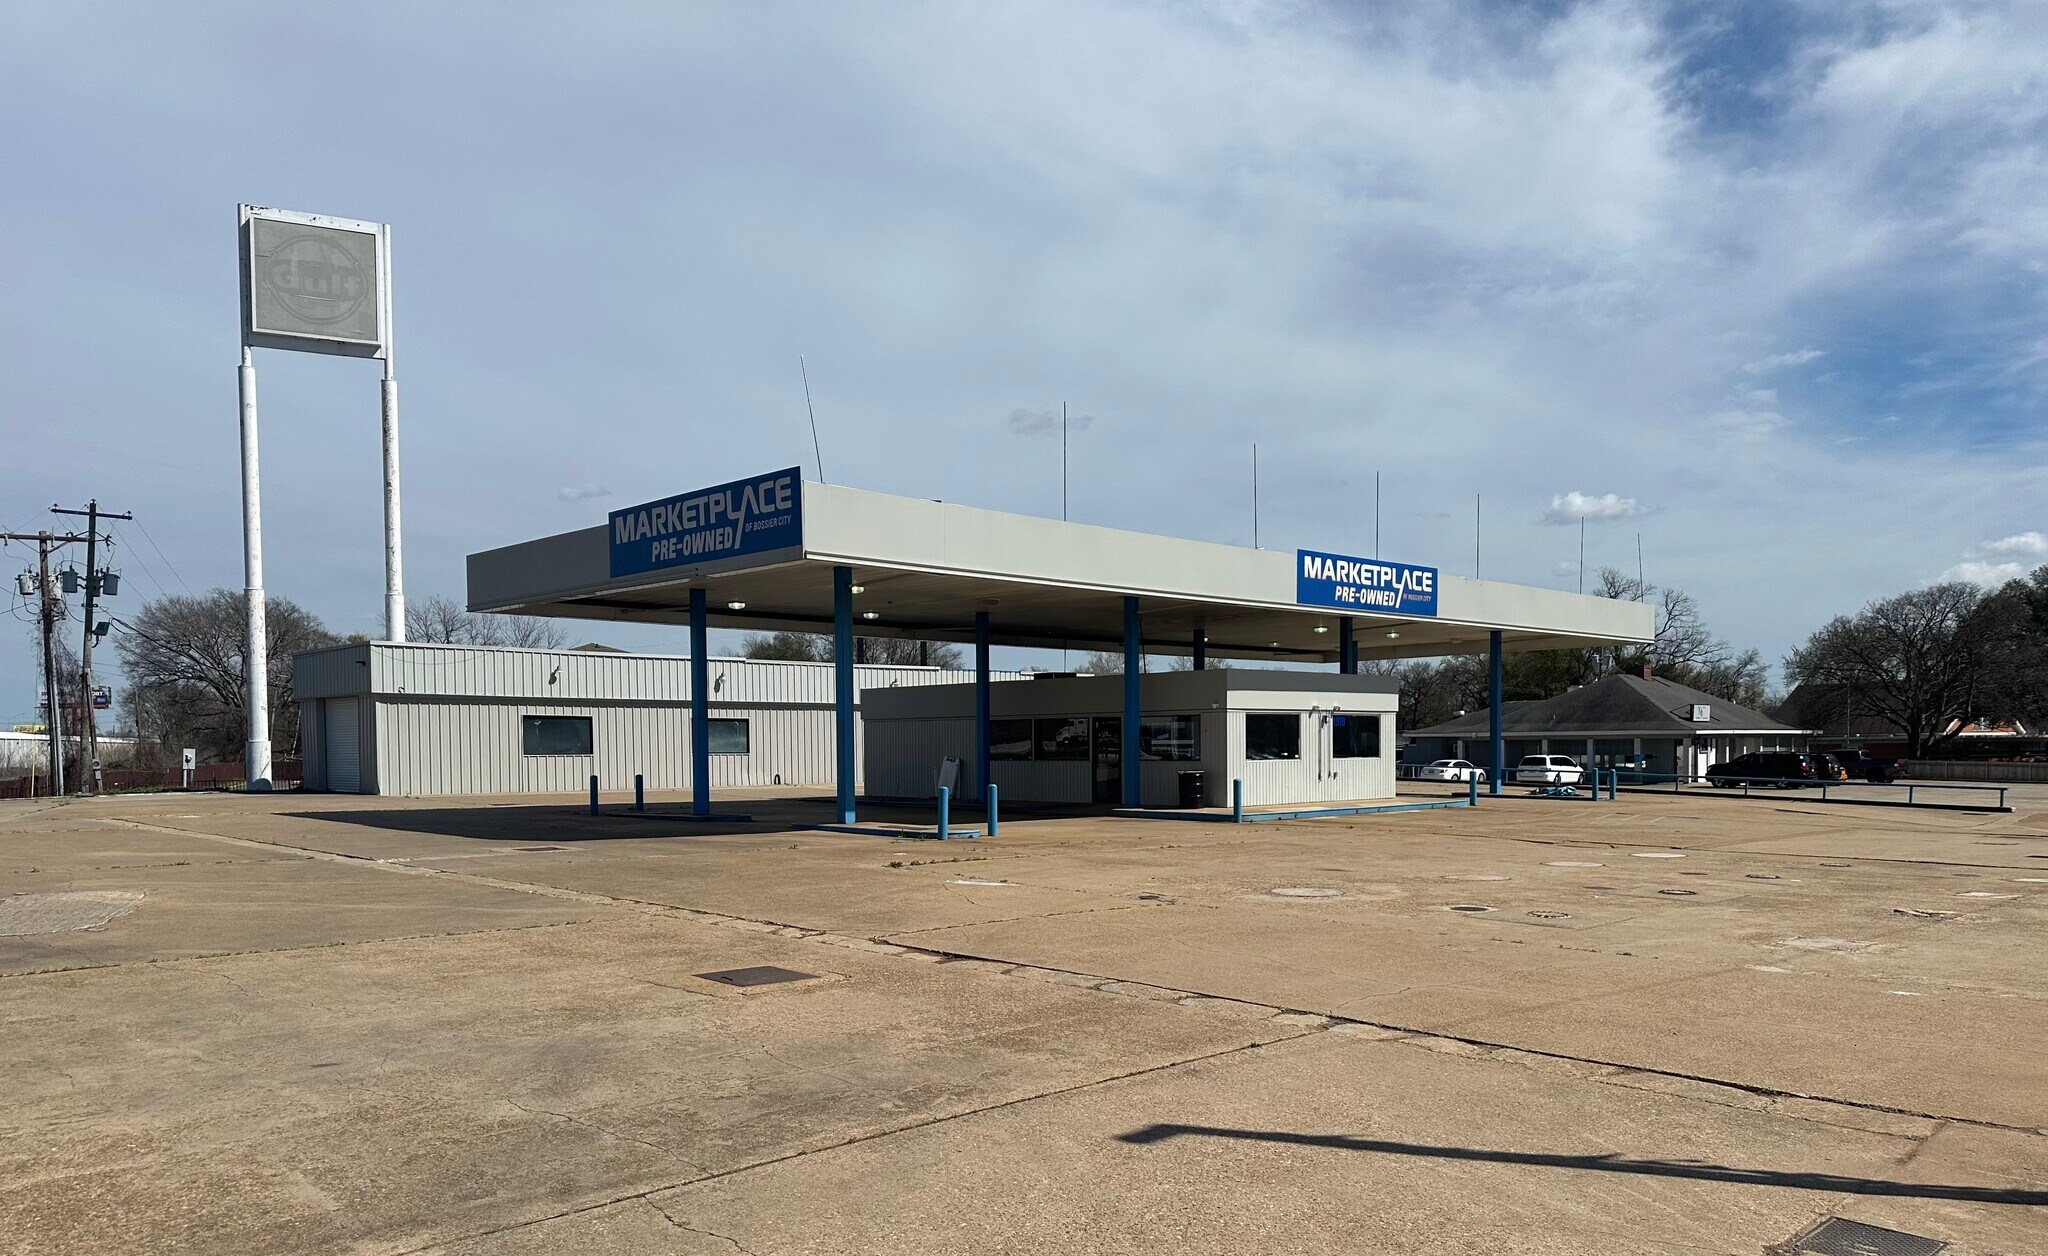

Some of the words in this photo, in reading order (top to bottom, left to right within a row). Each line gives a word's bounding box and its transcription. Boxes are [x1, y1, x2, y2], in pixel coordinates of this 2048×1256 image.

[615, 476, 793, 549] MARKETPLACE
[744, 522, 753, 532] OF
[753, 517, 778, 531] BOSSIER
[777, 514, 792, 526] CITY
[651, 526, 733, 563] PRE-OWNED
[1304, 555, 1433, 608] MARKETPLACE
[1335, 585, 1396, 607] PRE-OWNED
